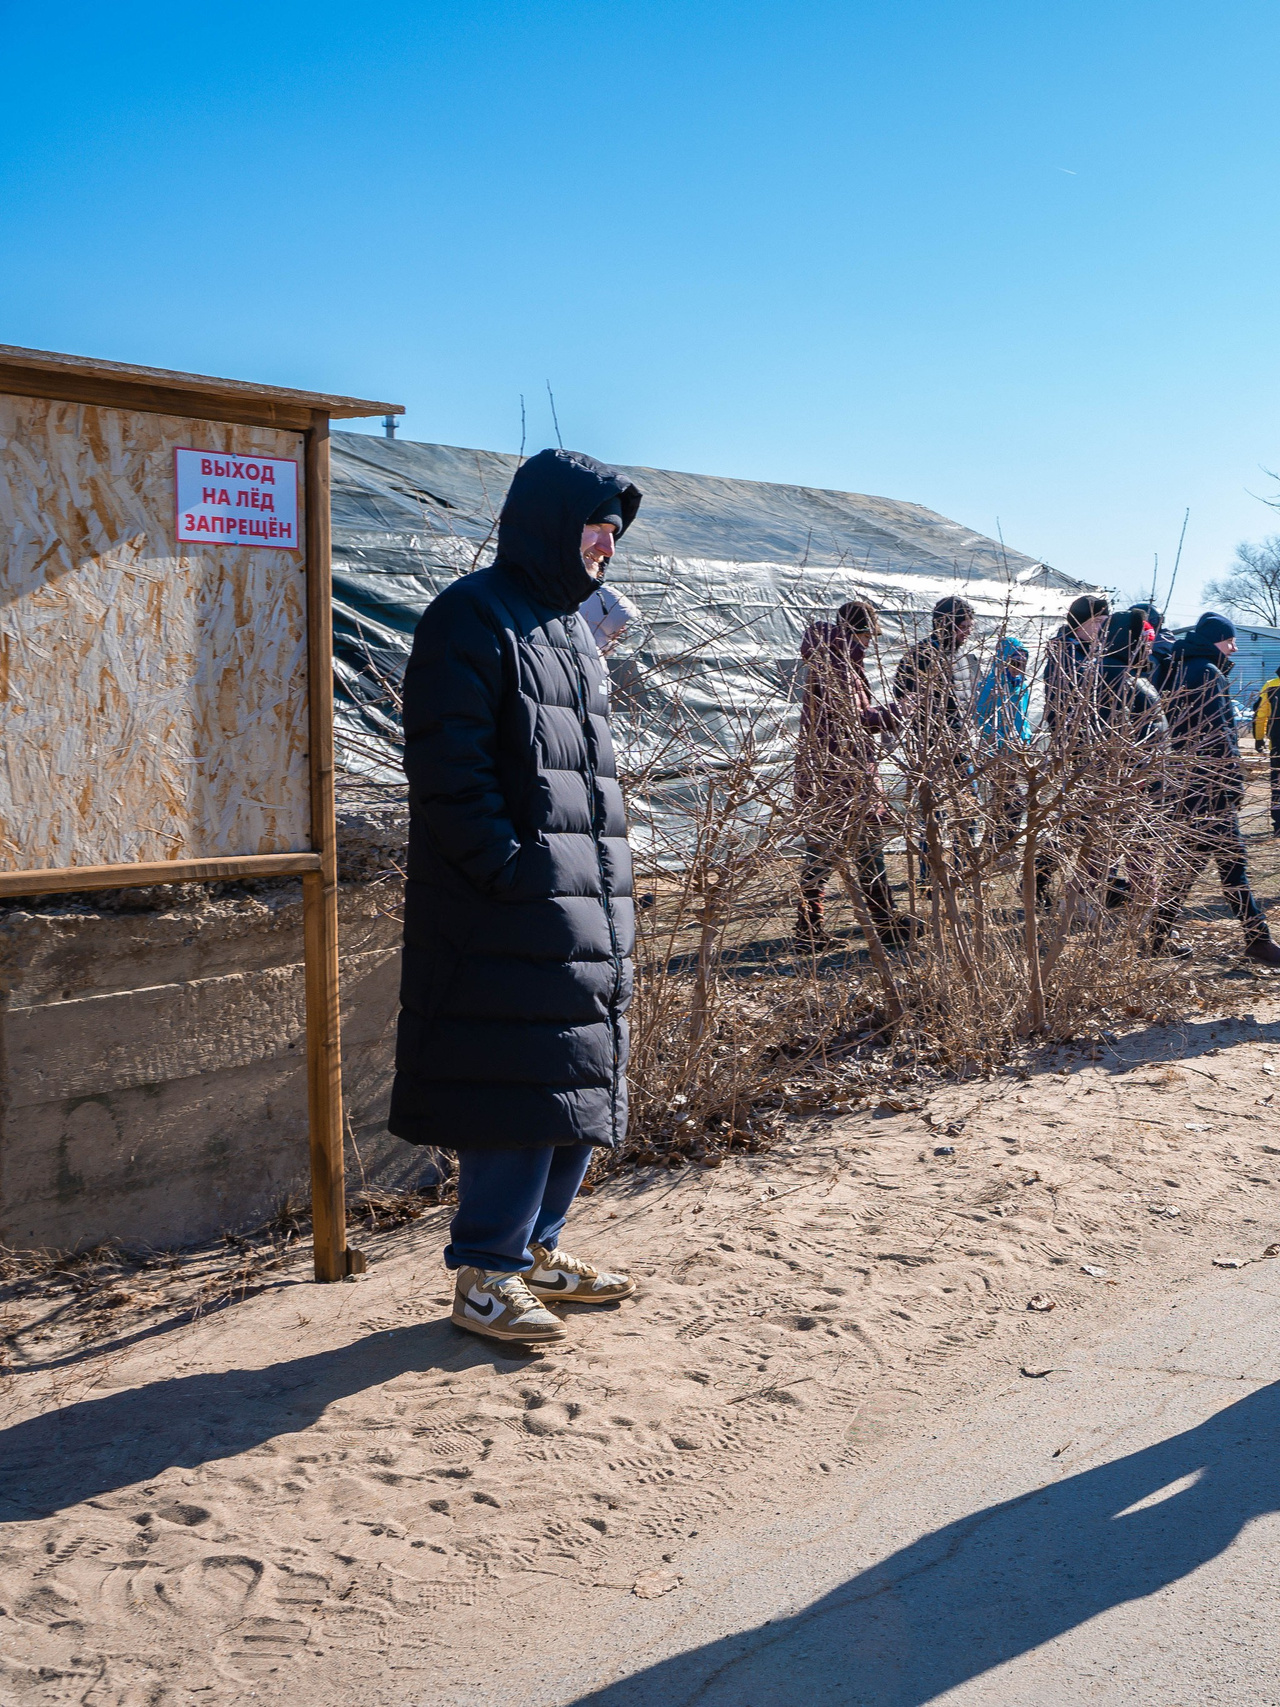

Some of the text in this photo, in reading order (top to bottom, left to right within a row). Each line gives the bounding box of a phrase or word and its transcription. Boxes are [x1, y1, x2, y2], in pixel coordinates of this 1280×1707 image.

[201, 459, 275, 485] ВЫХОД
[202, 487, 275, 513] НА ЛЁД
[184, 514, 291, 540] ЗАПРЕЩЁН
